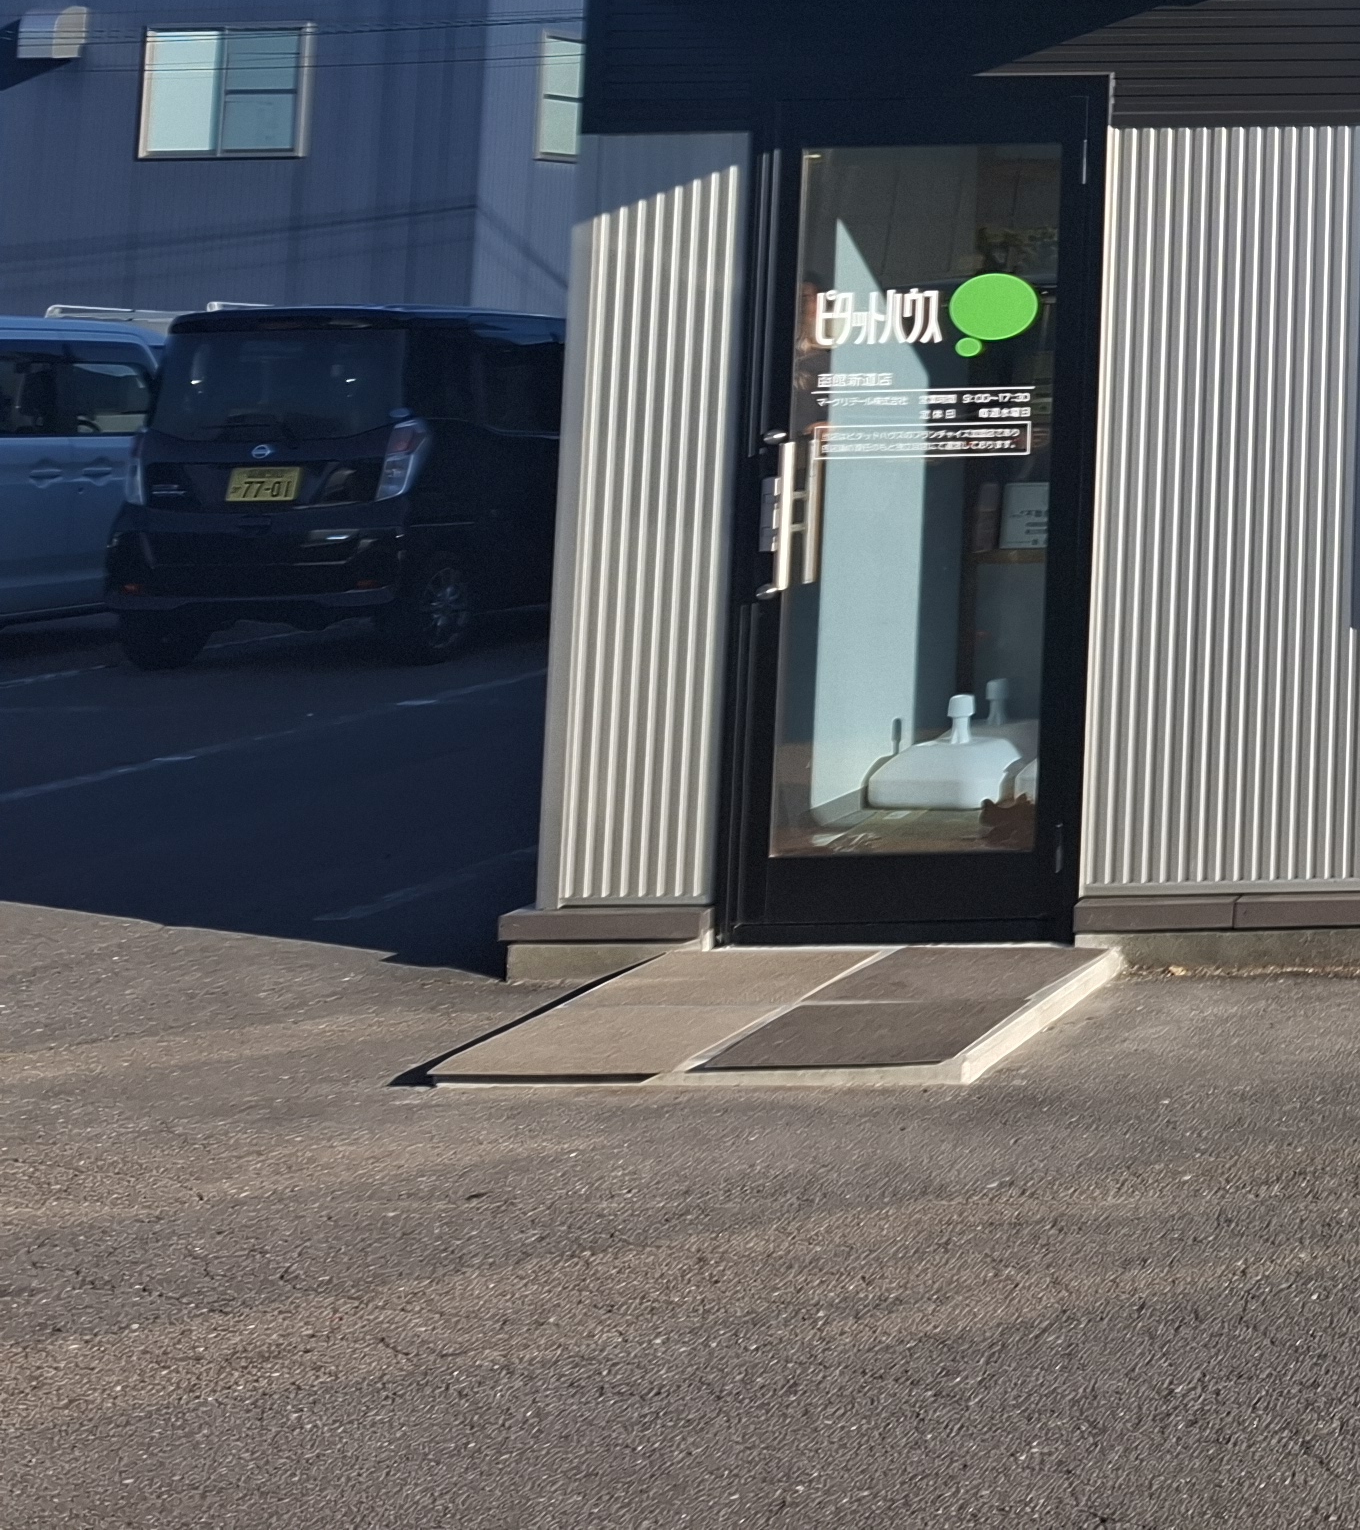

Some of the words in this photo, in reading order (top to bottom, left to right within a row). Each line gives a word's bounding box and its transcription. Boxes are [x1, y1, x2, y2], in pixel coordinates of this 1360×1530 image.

[815, 288, 943, 346] ピタットハウス
[241, 480, 293, 498] 77-01
